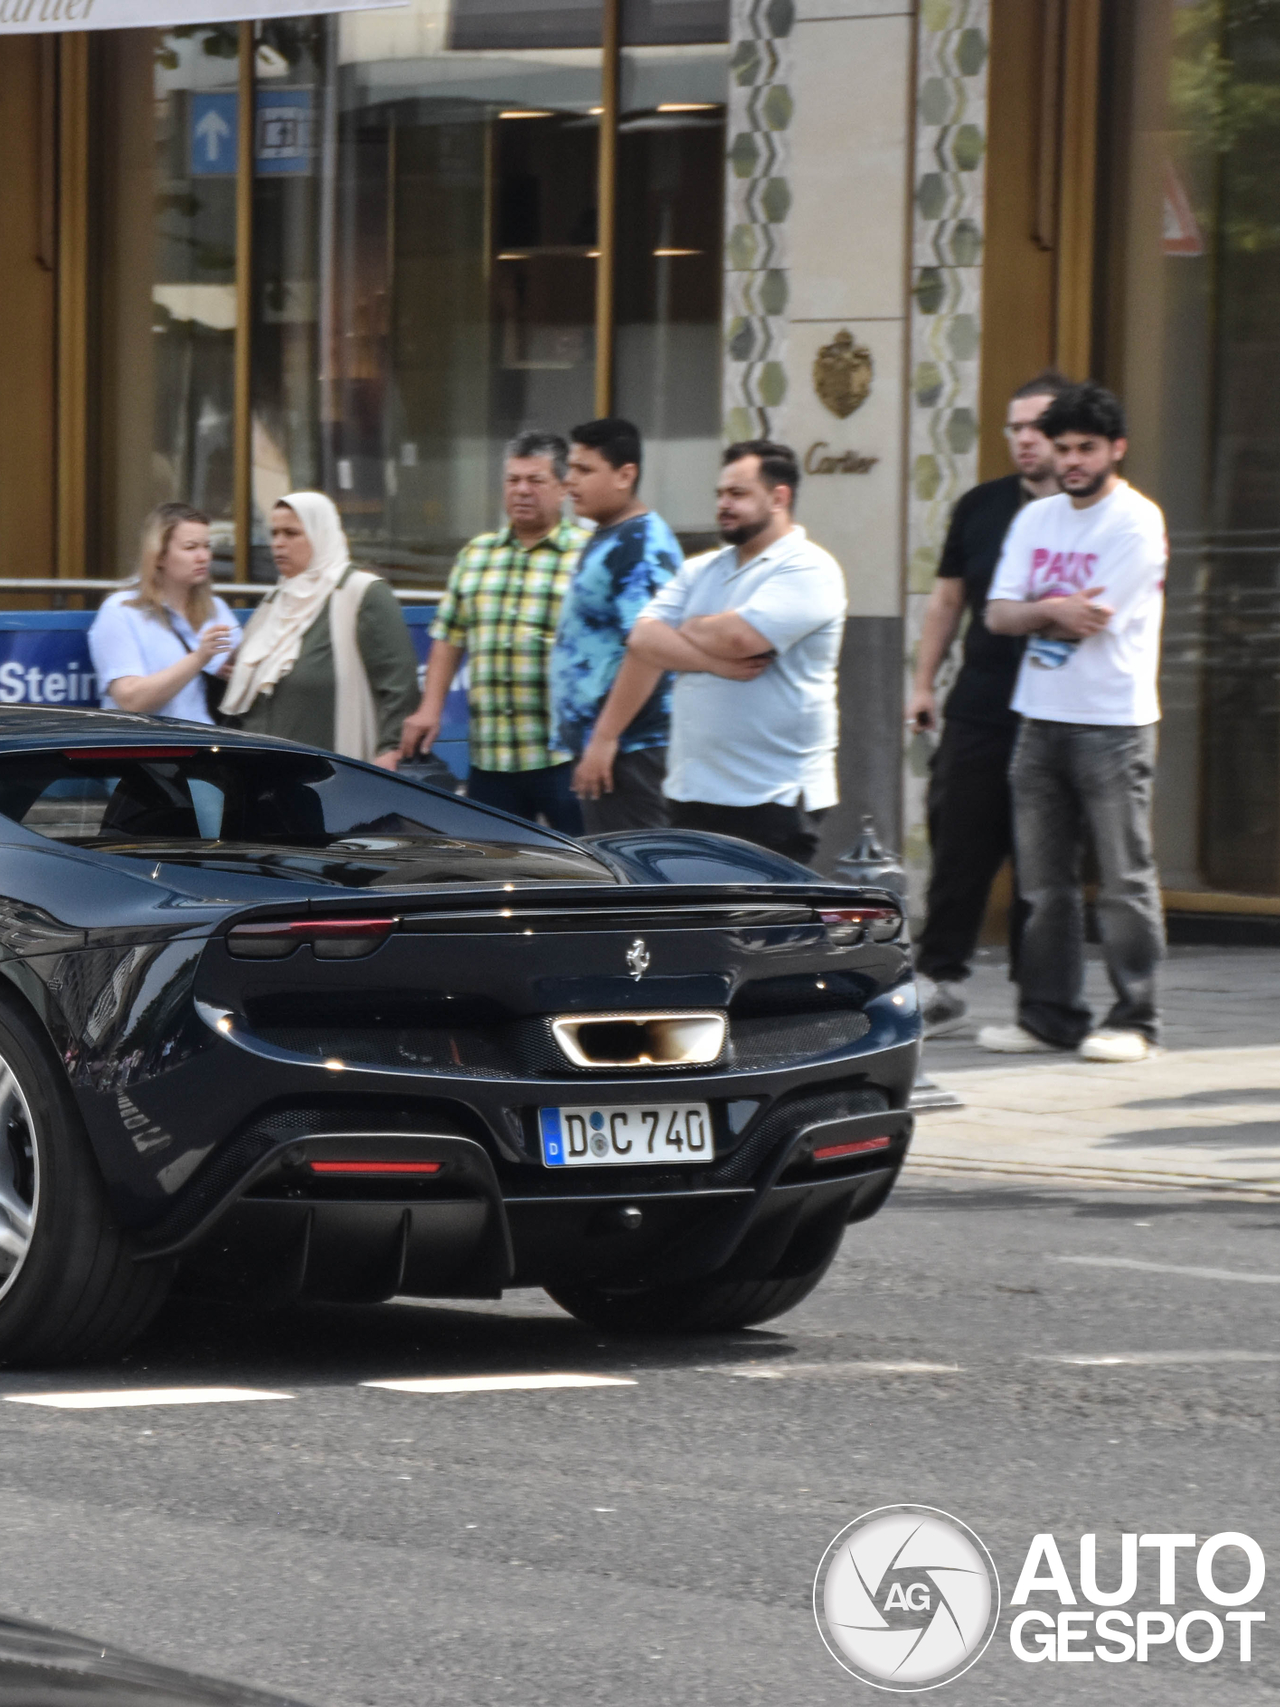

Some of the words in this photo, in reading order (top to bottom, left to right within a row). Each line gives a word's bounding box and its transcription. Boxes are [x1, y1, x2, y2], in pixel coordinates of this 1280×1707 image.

[804, 441, 880, 475] Cartier
[549, 1142, 559, 1156] D
[565, 1114, 588, 1157] D
[610, 1112, 632, 1155] C
[641, 1110, 705, 1154] 740
